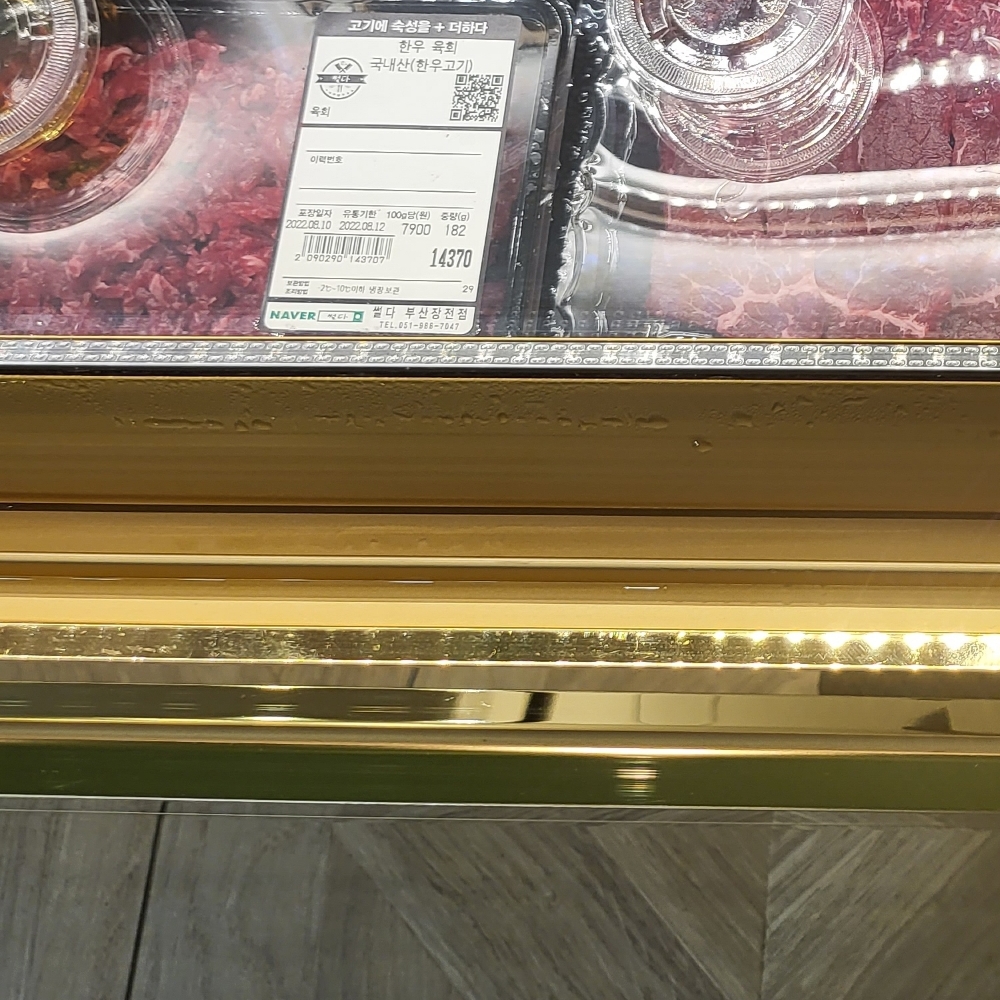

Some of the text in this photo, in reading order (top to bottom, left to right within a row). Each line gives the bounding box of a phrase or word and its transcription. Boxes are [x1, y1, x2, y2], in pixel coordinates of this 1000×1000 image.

[348, 20, 387, 33] 고기에
[391, 20, 431, 34] 숙성을
[448, 21, 488, 34] 더하다
[399, 40, 458, 54] 한우 육회
[370, 58, 473, 73] 국내산(한우고기)
[310, 107, 330, 117] 육회
[310, 155, 343, 164] 이력번호
[298, 209, 470, 221] 포장일자 유통기한 100g당(원) 중량(g)
[286, 220, 466, 236] 2022.08.10 2022.08.12 7900 182
[350, 255, 385, 263] 143707
[430, 248, 472, 268] 14370
[462, 285, 473, 293] 29
[270, 306, 468, 320] NAVER 썰다 부산장전점
